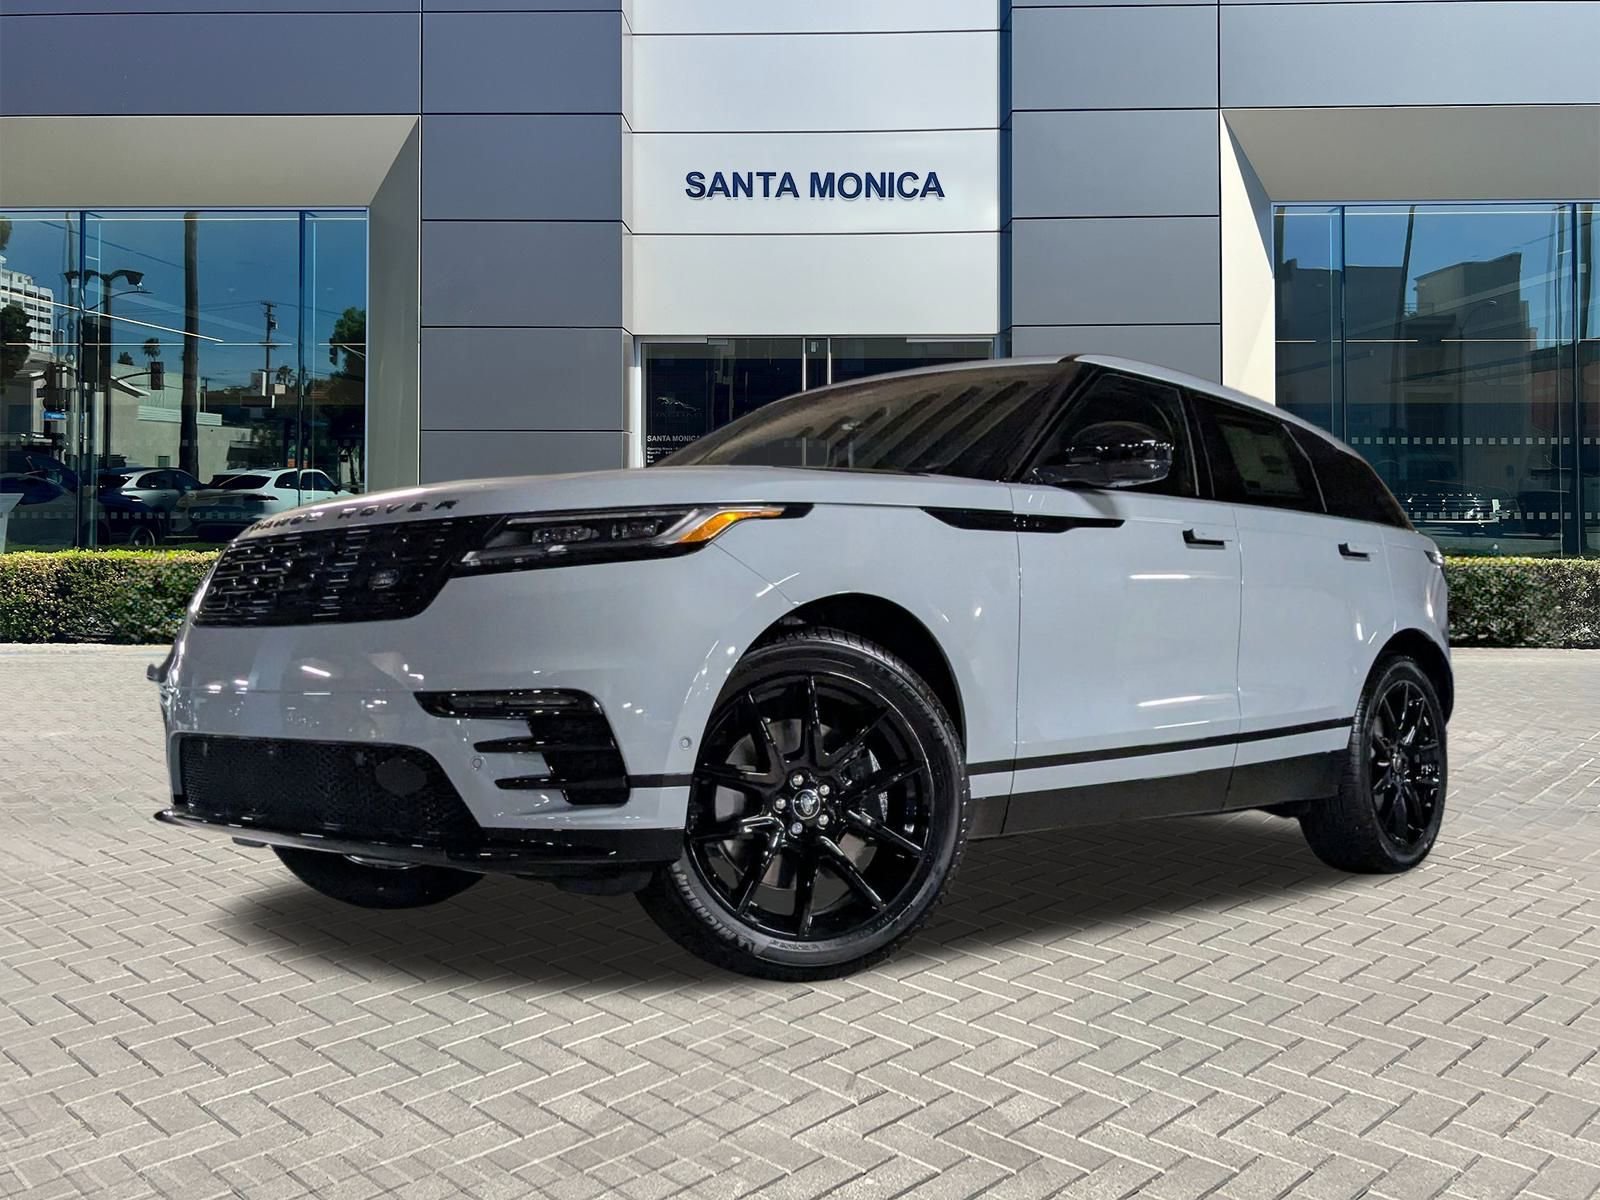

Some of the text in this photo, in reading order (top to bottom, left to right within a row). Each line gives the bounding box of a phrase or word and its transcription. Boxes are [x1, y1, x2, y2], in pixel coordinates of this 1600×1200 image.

[685, 171, 945, 199] SANTA MONICA
[337, 500, 462, 519] ROVER
[674, 873, 737, 940] MICHELIN
